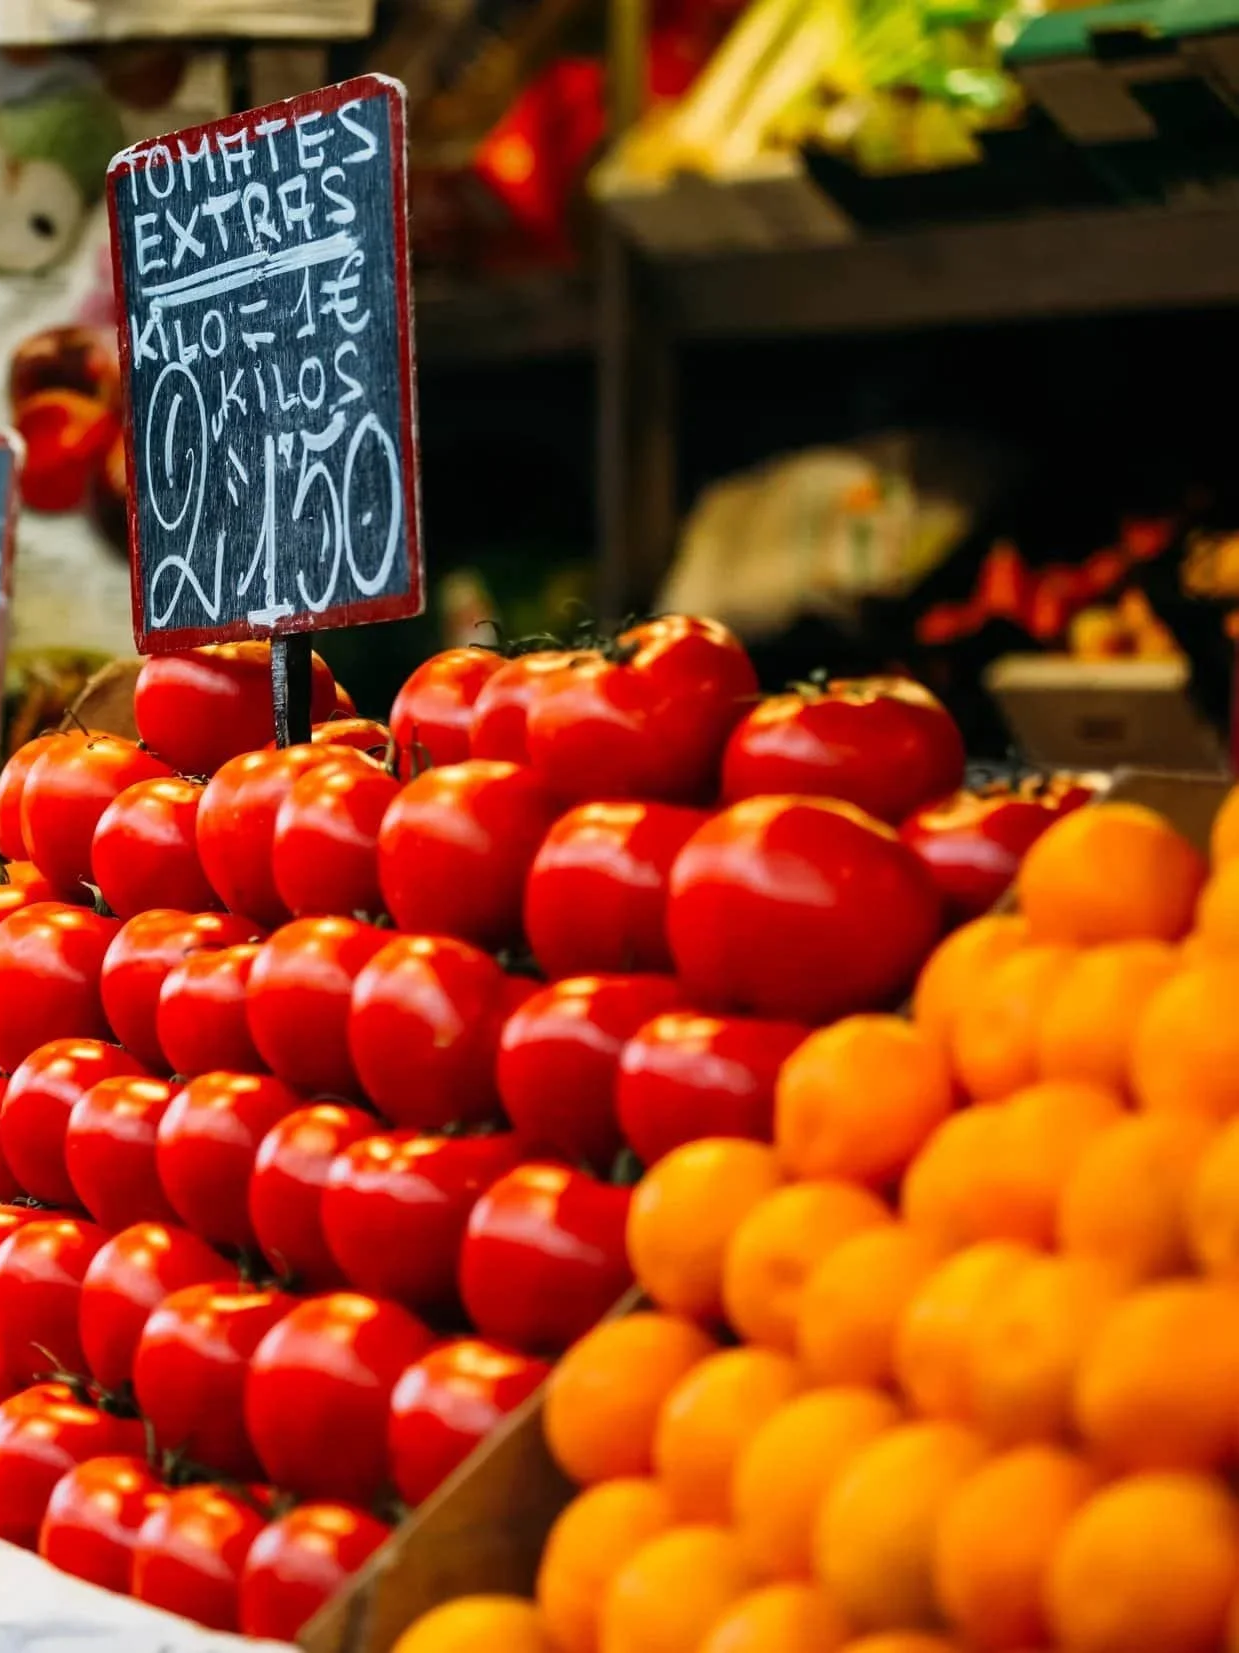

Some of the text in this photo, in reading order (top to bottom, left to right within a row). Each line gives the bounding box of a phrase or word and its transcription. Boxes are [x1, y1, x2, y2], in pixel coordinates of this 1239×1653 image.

[121, 98, 378, 205] TOMATES
[134, 166, 357, 275] EXTRAS
[131, 306, 226, 370] KILO
[213, 341, 365, 442] KILOS
